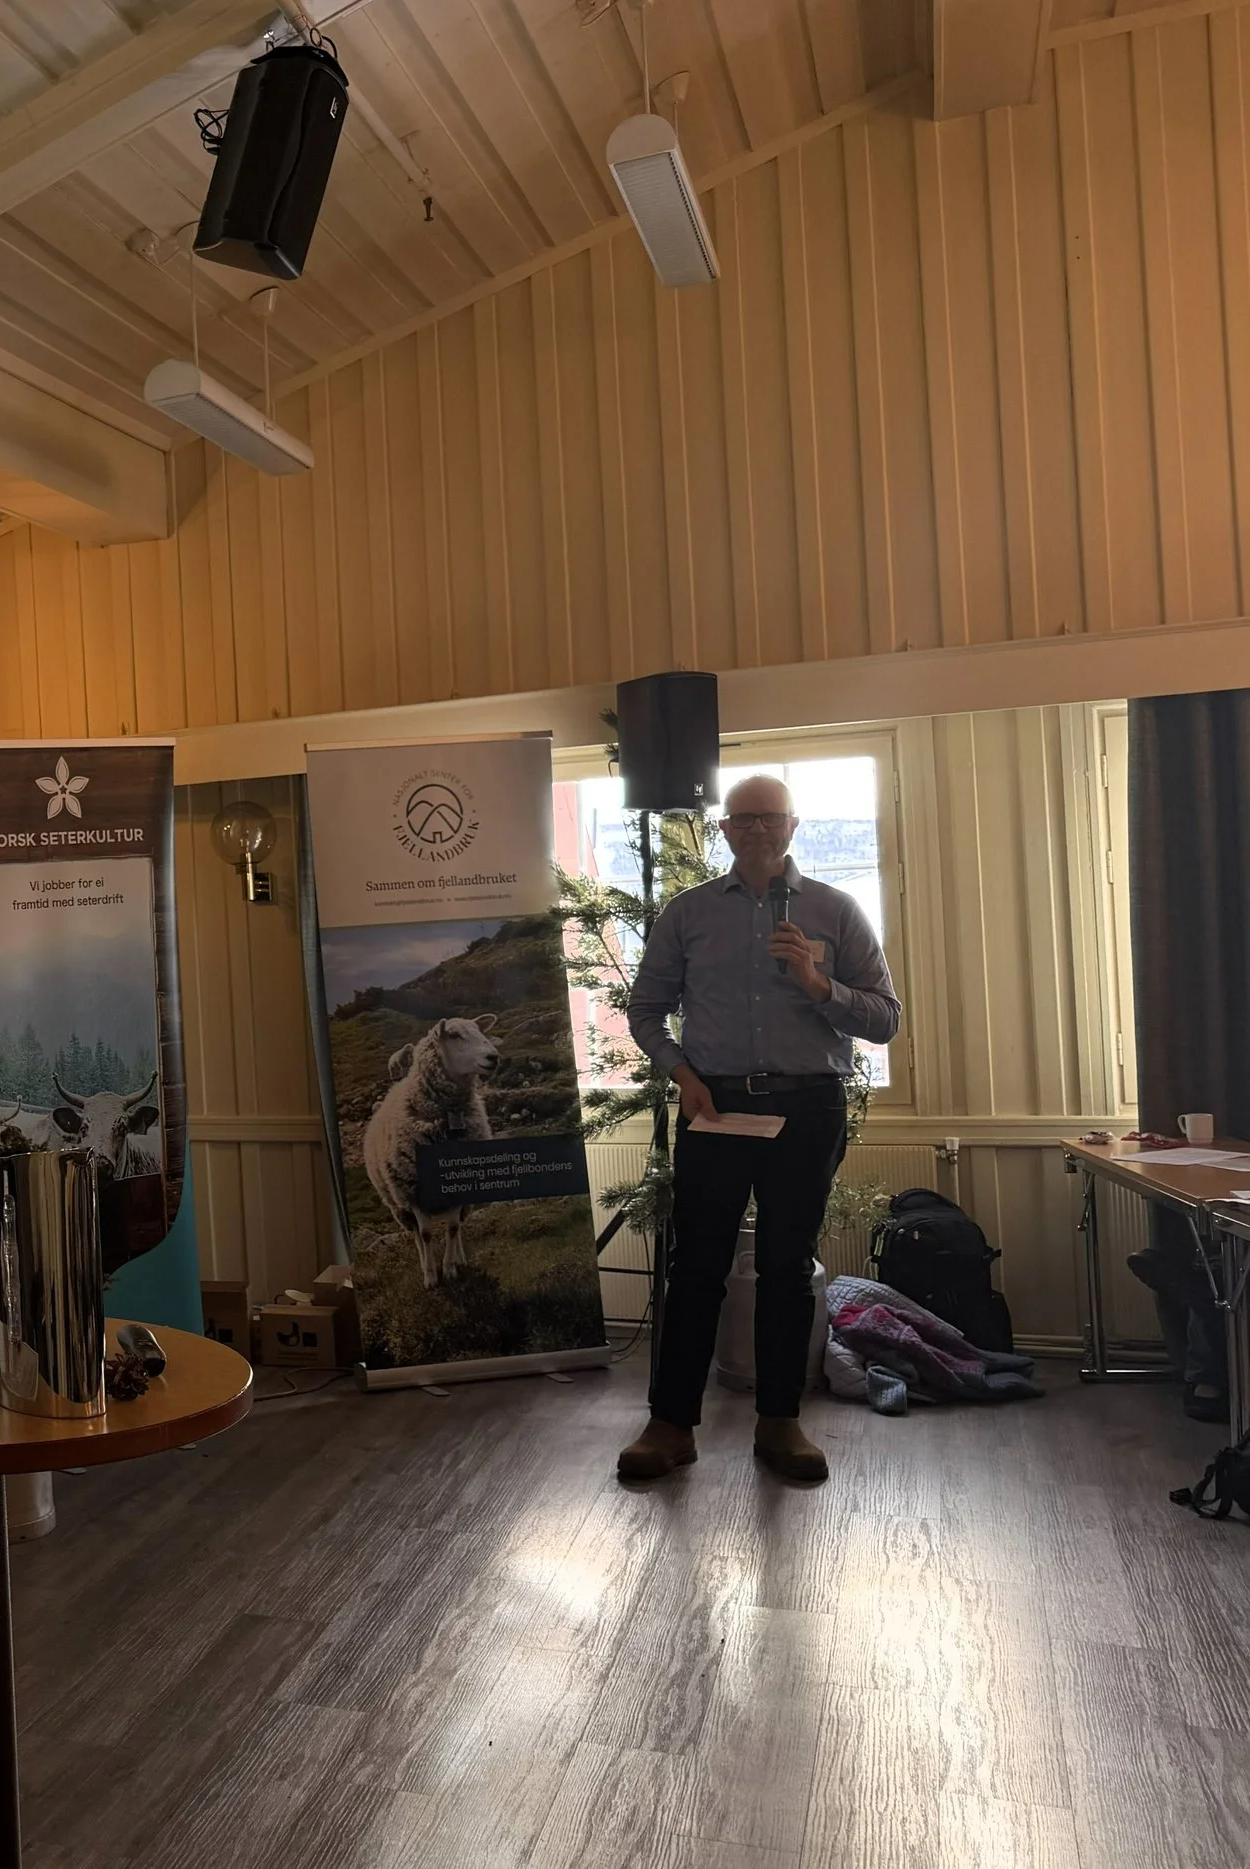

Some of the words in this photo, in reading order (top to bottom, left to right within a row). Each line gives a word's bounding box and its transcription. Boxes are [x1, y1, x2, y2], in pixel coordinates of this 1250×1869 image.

[40, 828, 144, 846] SETERKULTUR
[29, 881, 40, 891] Vi
[41, 880, 75, 892] jobber
[78, 879, 94, 890] for
[95, 877, 104, 888] ei
[365, 881, 414, 892] Sammen
[417, 880, 436, 889] om
[438, 873, 517, 890] fjellandbruket
[12, 899, 49, 911] framtid
[51, 898, 75, 909] med
[77, 893, 124, 907] seterdrift
[438, 1153, 520, 1168] Kunnskapsdeling
[523, 1152, 537, 1163] og
[440, 1169, 485, 1182] -utvikling
[487, 1165, 510, 1177] med
[512, 1161, 573, 1177] fjellbondens
[441, 1183, 472, 1194] behov
[480, 1179, 520, 1191] sentrum
